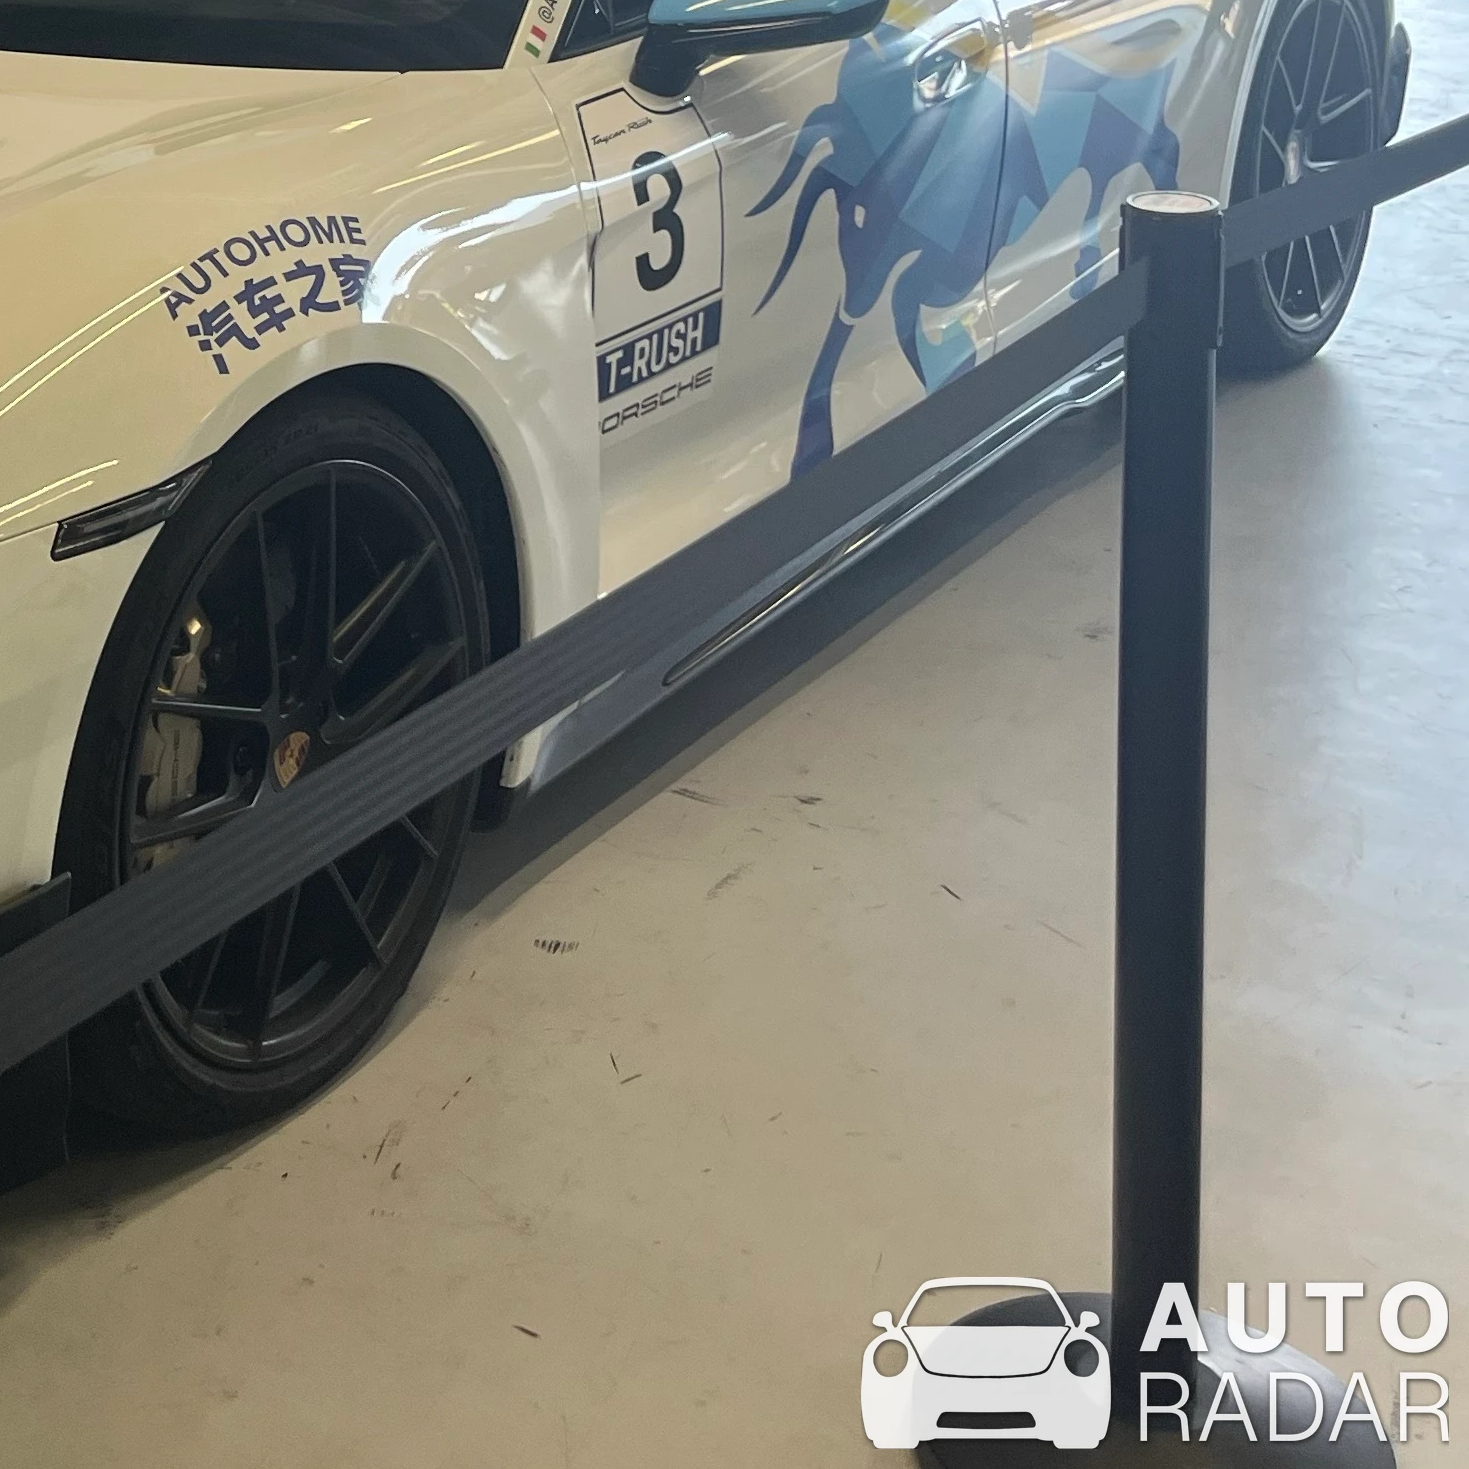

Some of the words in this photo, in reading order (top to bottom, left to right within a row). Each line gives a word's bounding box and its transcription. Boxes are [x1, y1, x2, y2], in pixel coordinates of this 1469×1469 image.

[159, 215, 367, 321] AUTOHOME
[632, 150, 685, 292] 3
[186, 253, 374, 375] 汽车之家
[605, 311, 705, 394] T-RUSH
[597, 366, 714, 435] ORSCHE
